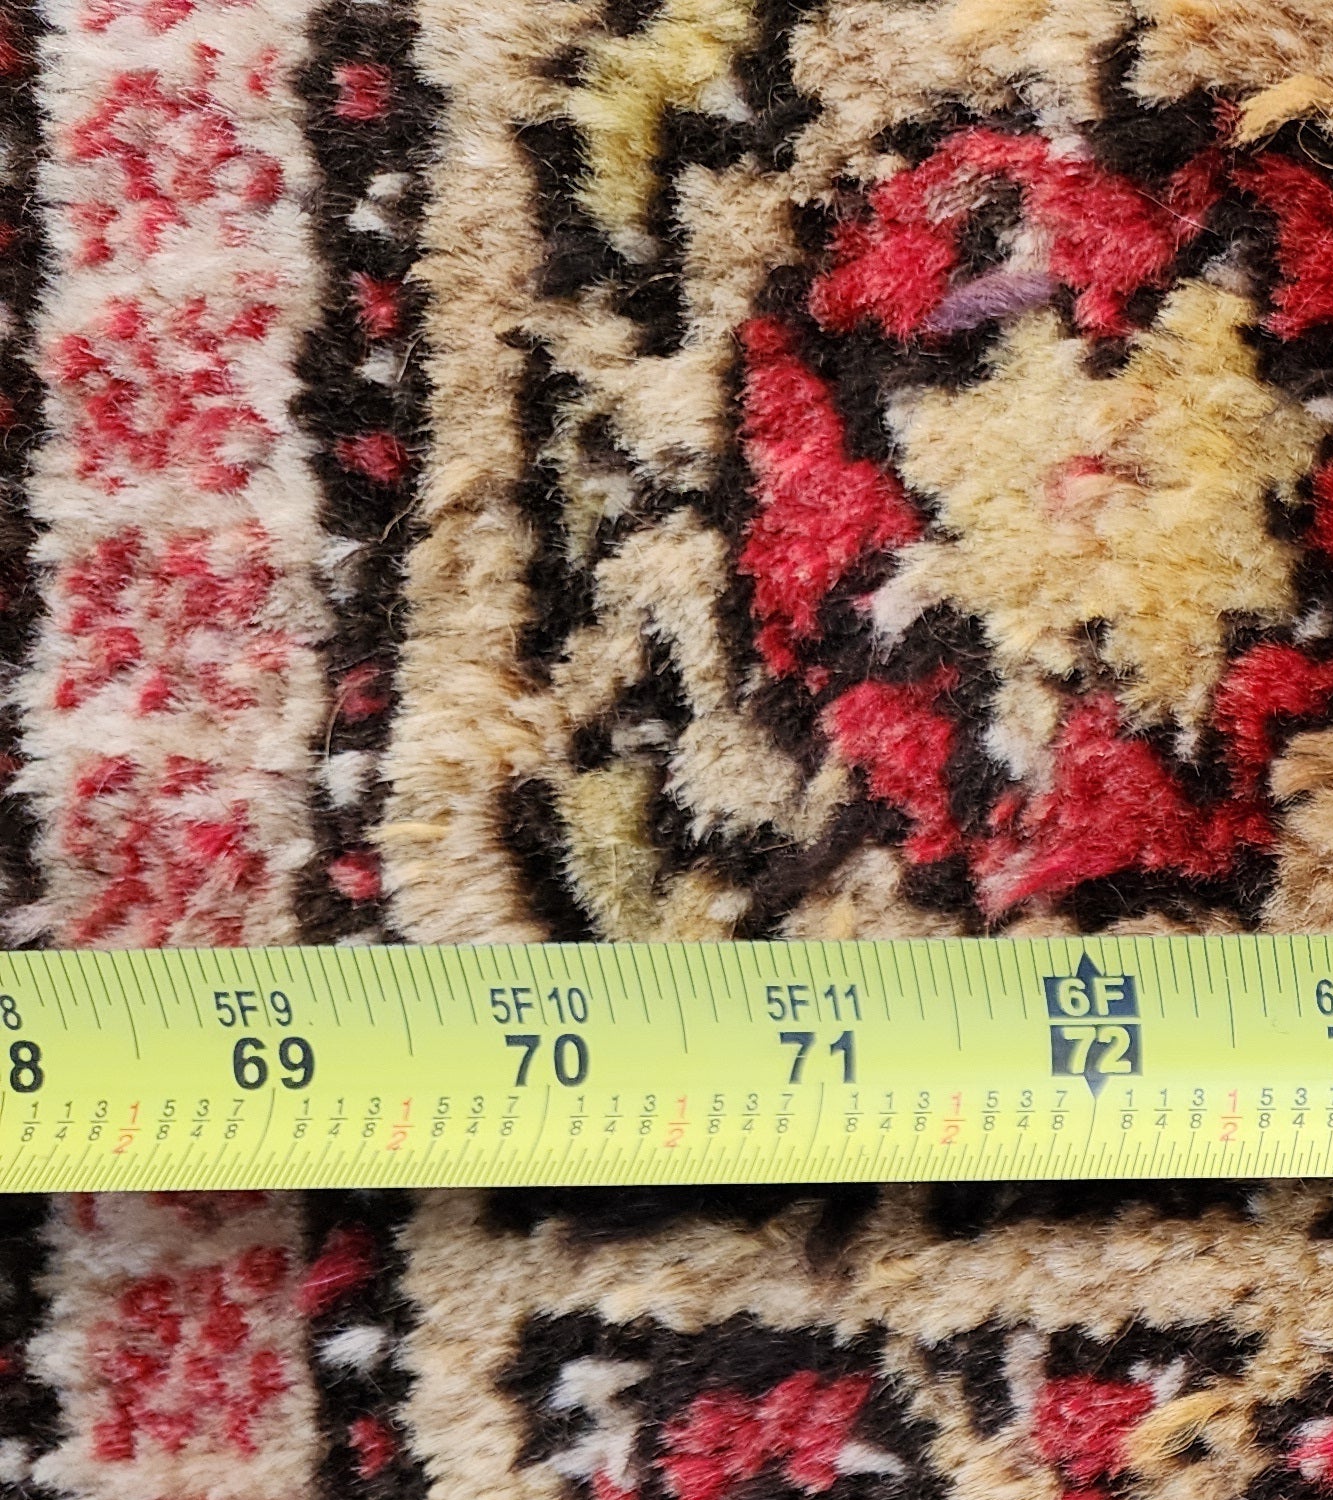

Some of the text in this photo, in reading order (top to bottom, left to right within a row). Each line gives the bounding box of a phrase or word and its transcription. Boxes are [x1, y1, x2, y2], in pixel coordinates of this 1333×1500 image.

[1058, 979, 1125, 1016] 6F
[233, 1037, 314, 1090] 69
[505, 1034, 588, 1086] 70
[780, 1031, 853, 1083] 71
[1064, 1026, 1132, 1075] 72
